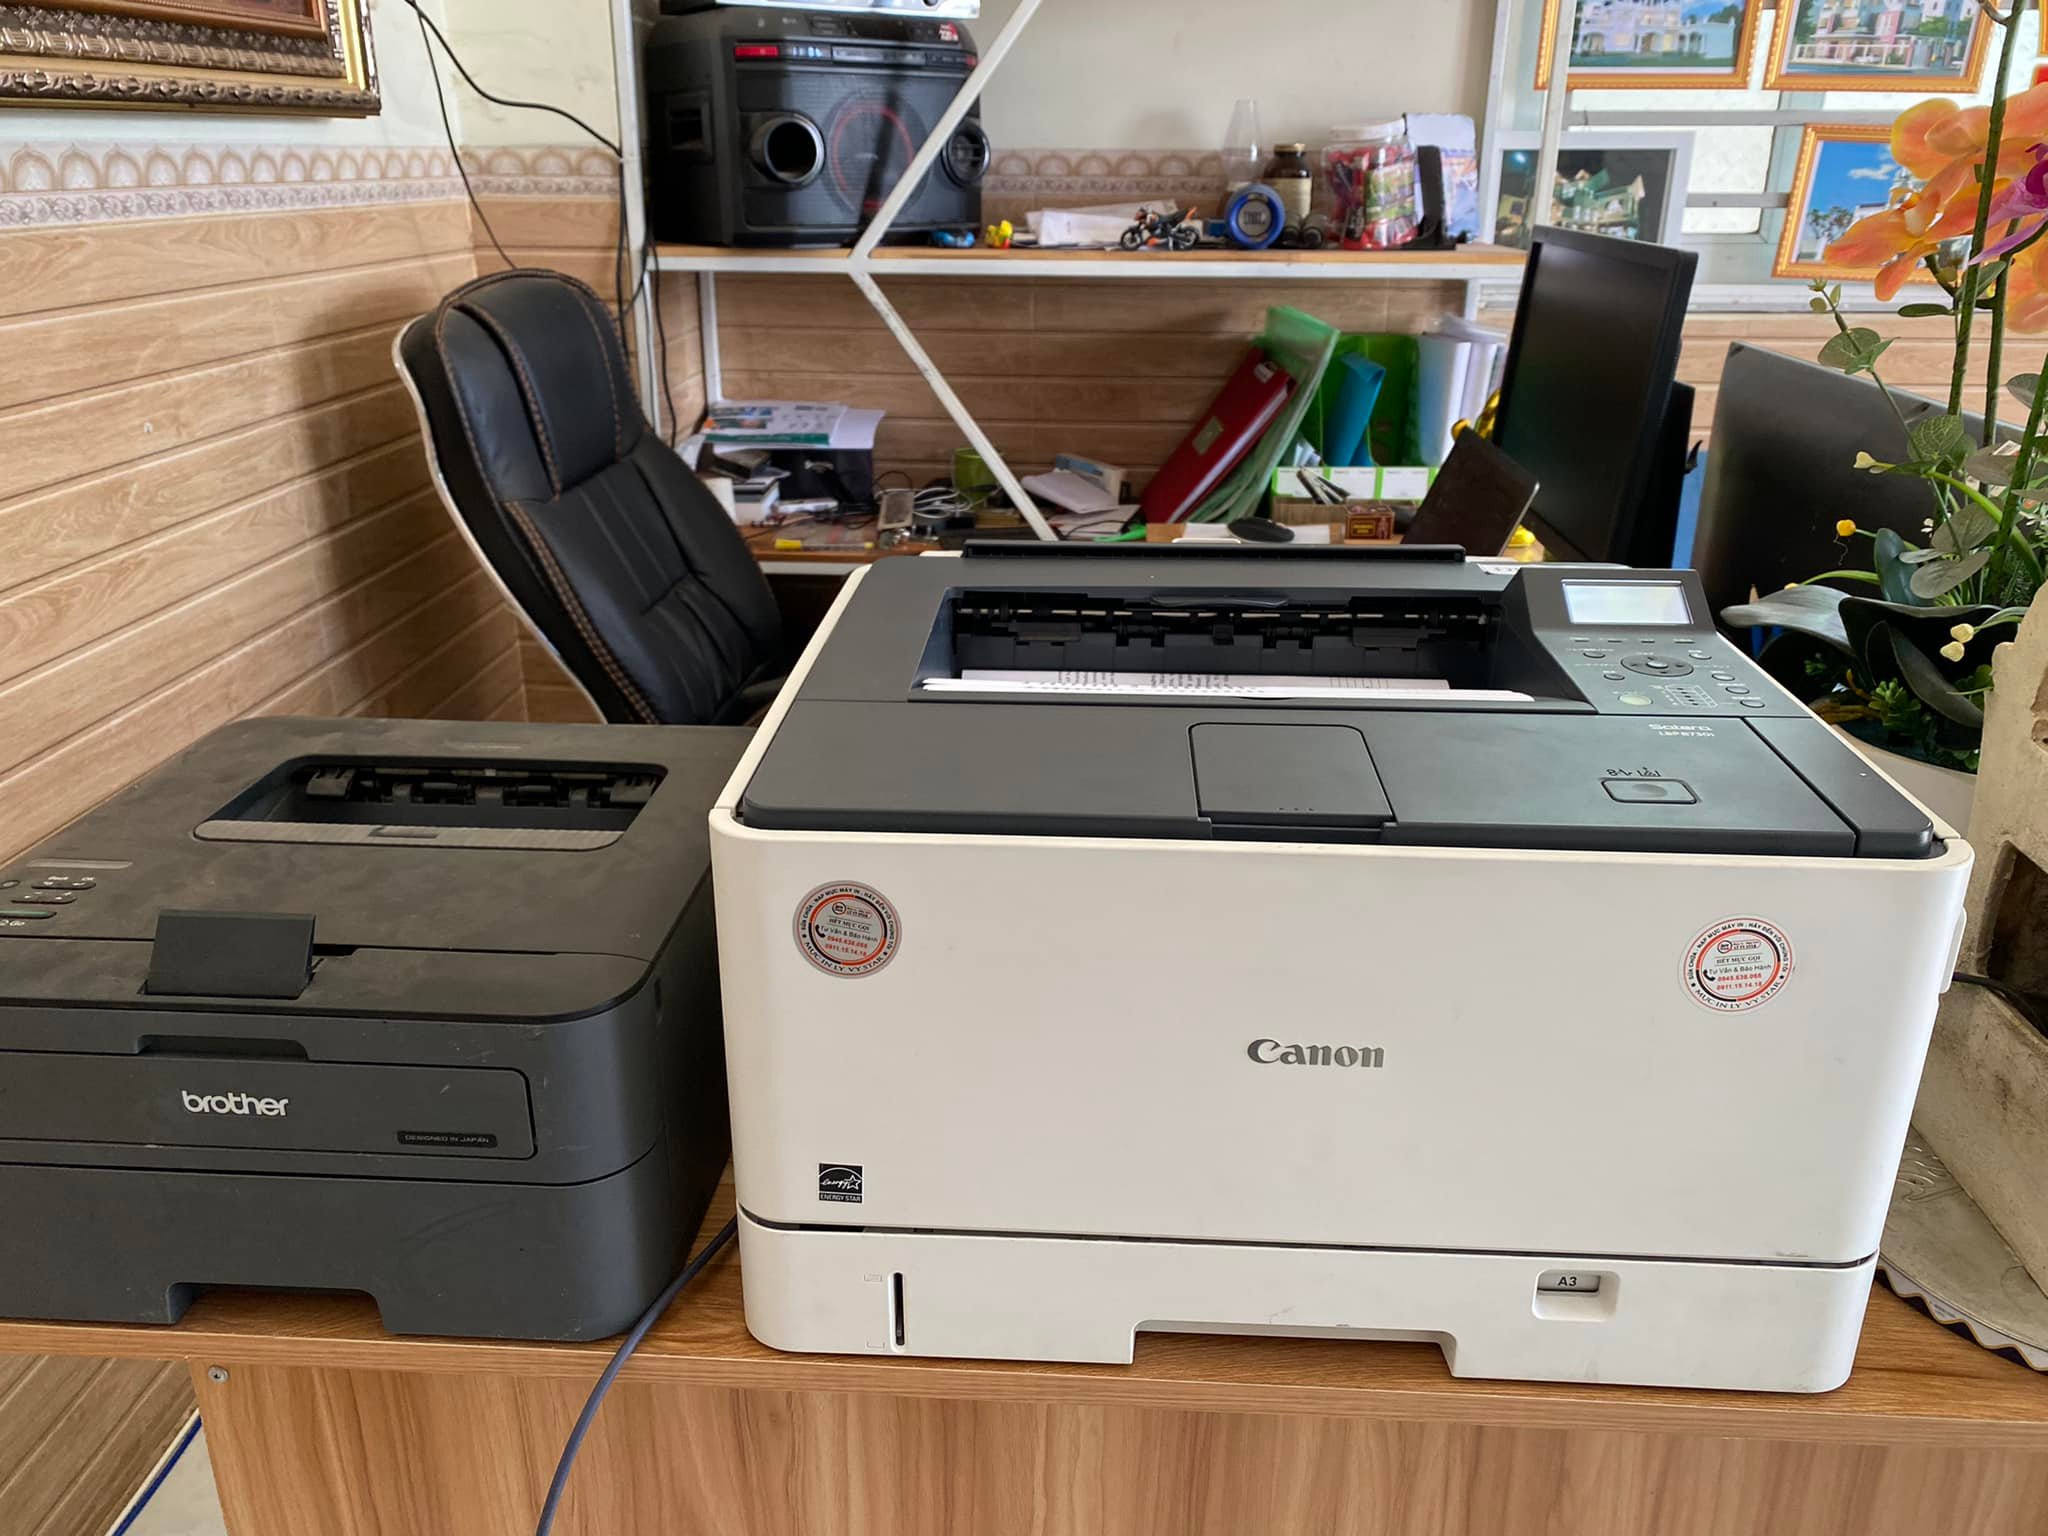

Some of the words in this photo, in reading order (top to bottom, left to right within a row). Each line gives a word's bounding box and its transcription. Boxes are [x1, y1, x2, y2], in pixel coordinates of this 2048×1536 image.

[861, 957, 884, 970] STAR
[1760, 982, 1781, 999] STAR
[1247, 1038, 1385, 1068] Canon
[181, 1089, 289, 1117] brother
[1558, 1276, 1577, 1287] A3
